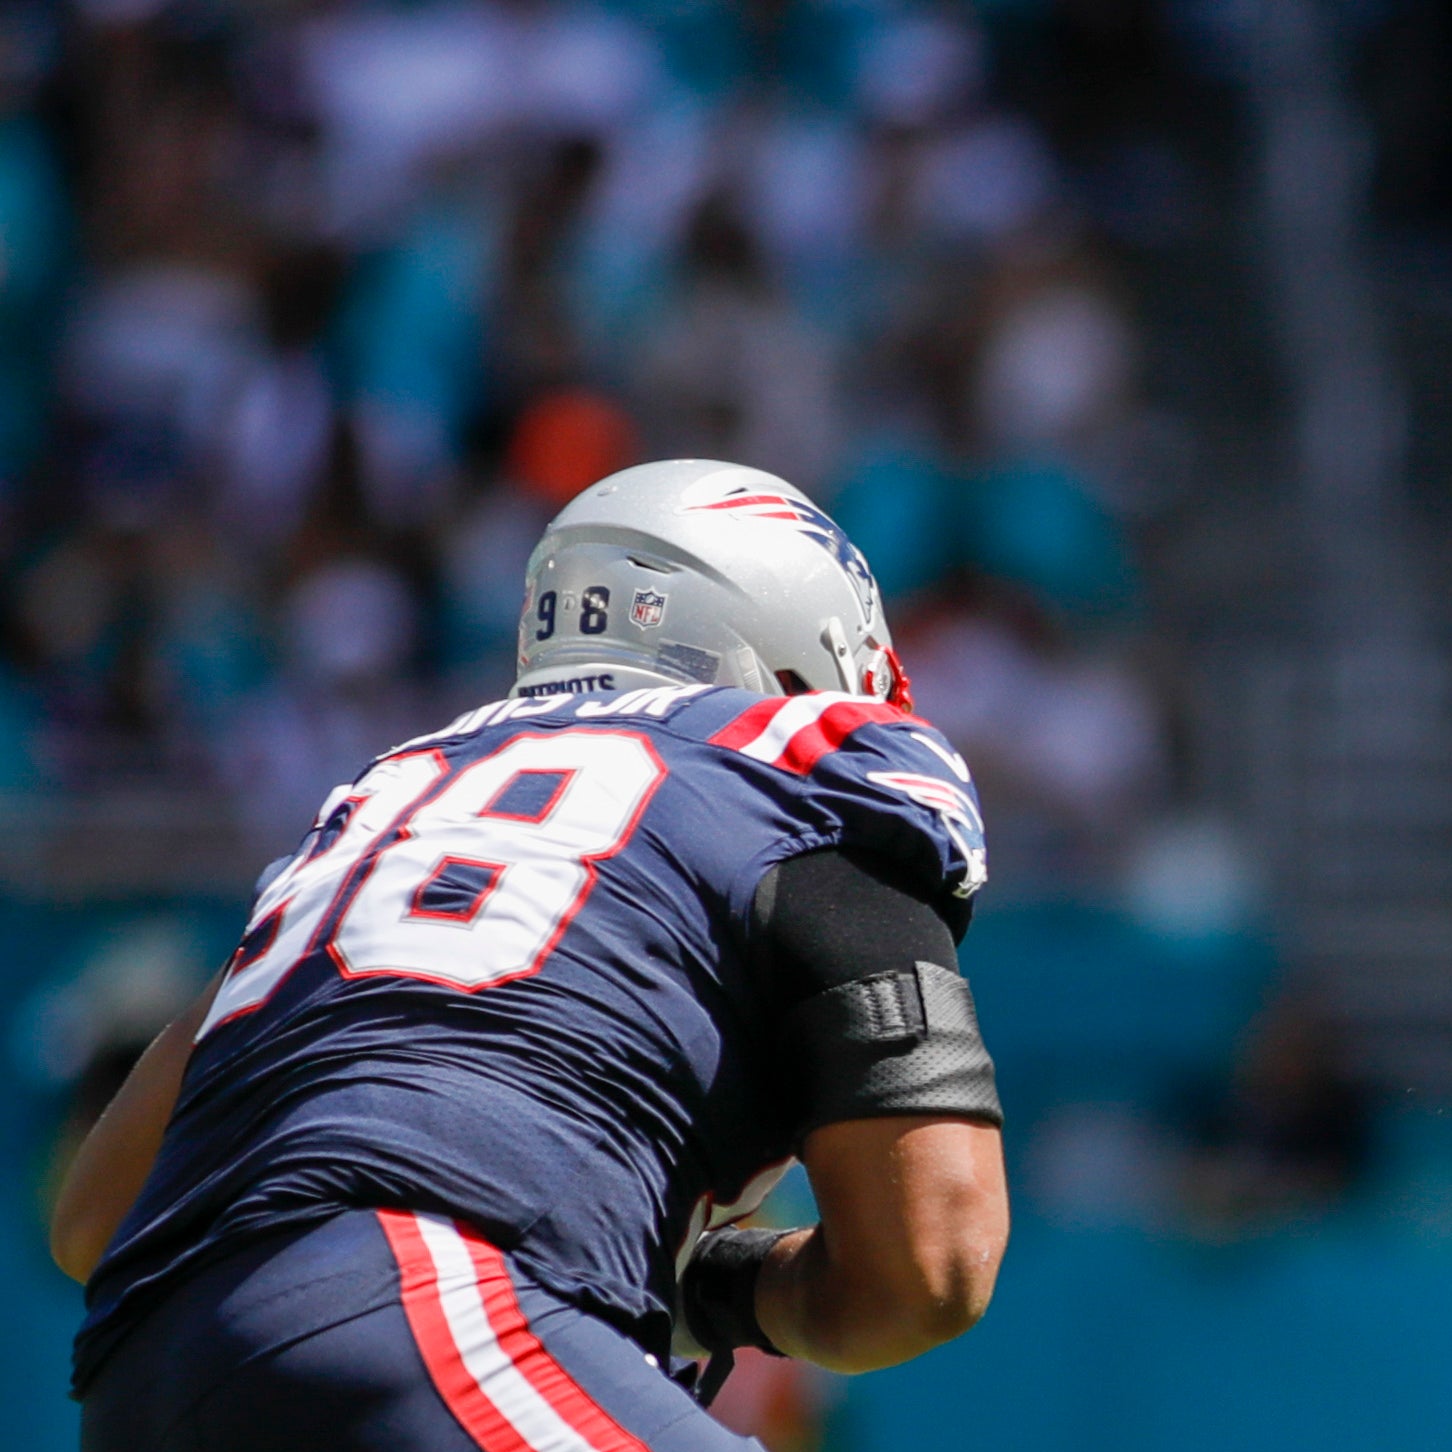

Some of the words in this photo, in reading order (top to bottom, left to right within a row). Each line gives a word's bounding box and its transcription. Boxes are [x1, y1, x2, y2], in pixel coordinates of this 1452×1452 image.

[536, 585, 610, 641] 98
[633, 603, 660, 623] NFL
[192, 728, 669, 1046] 98
